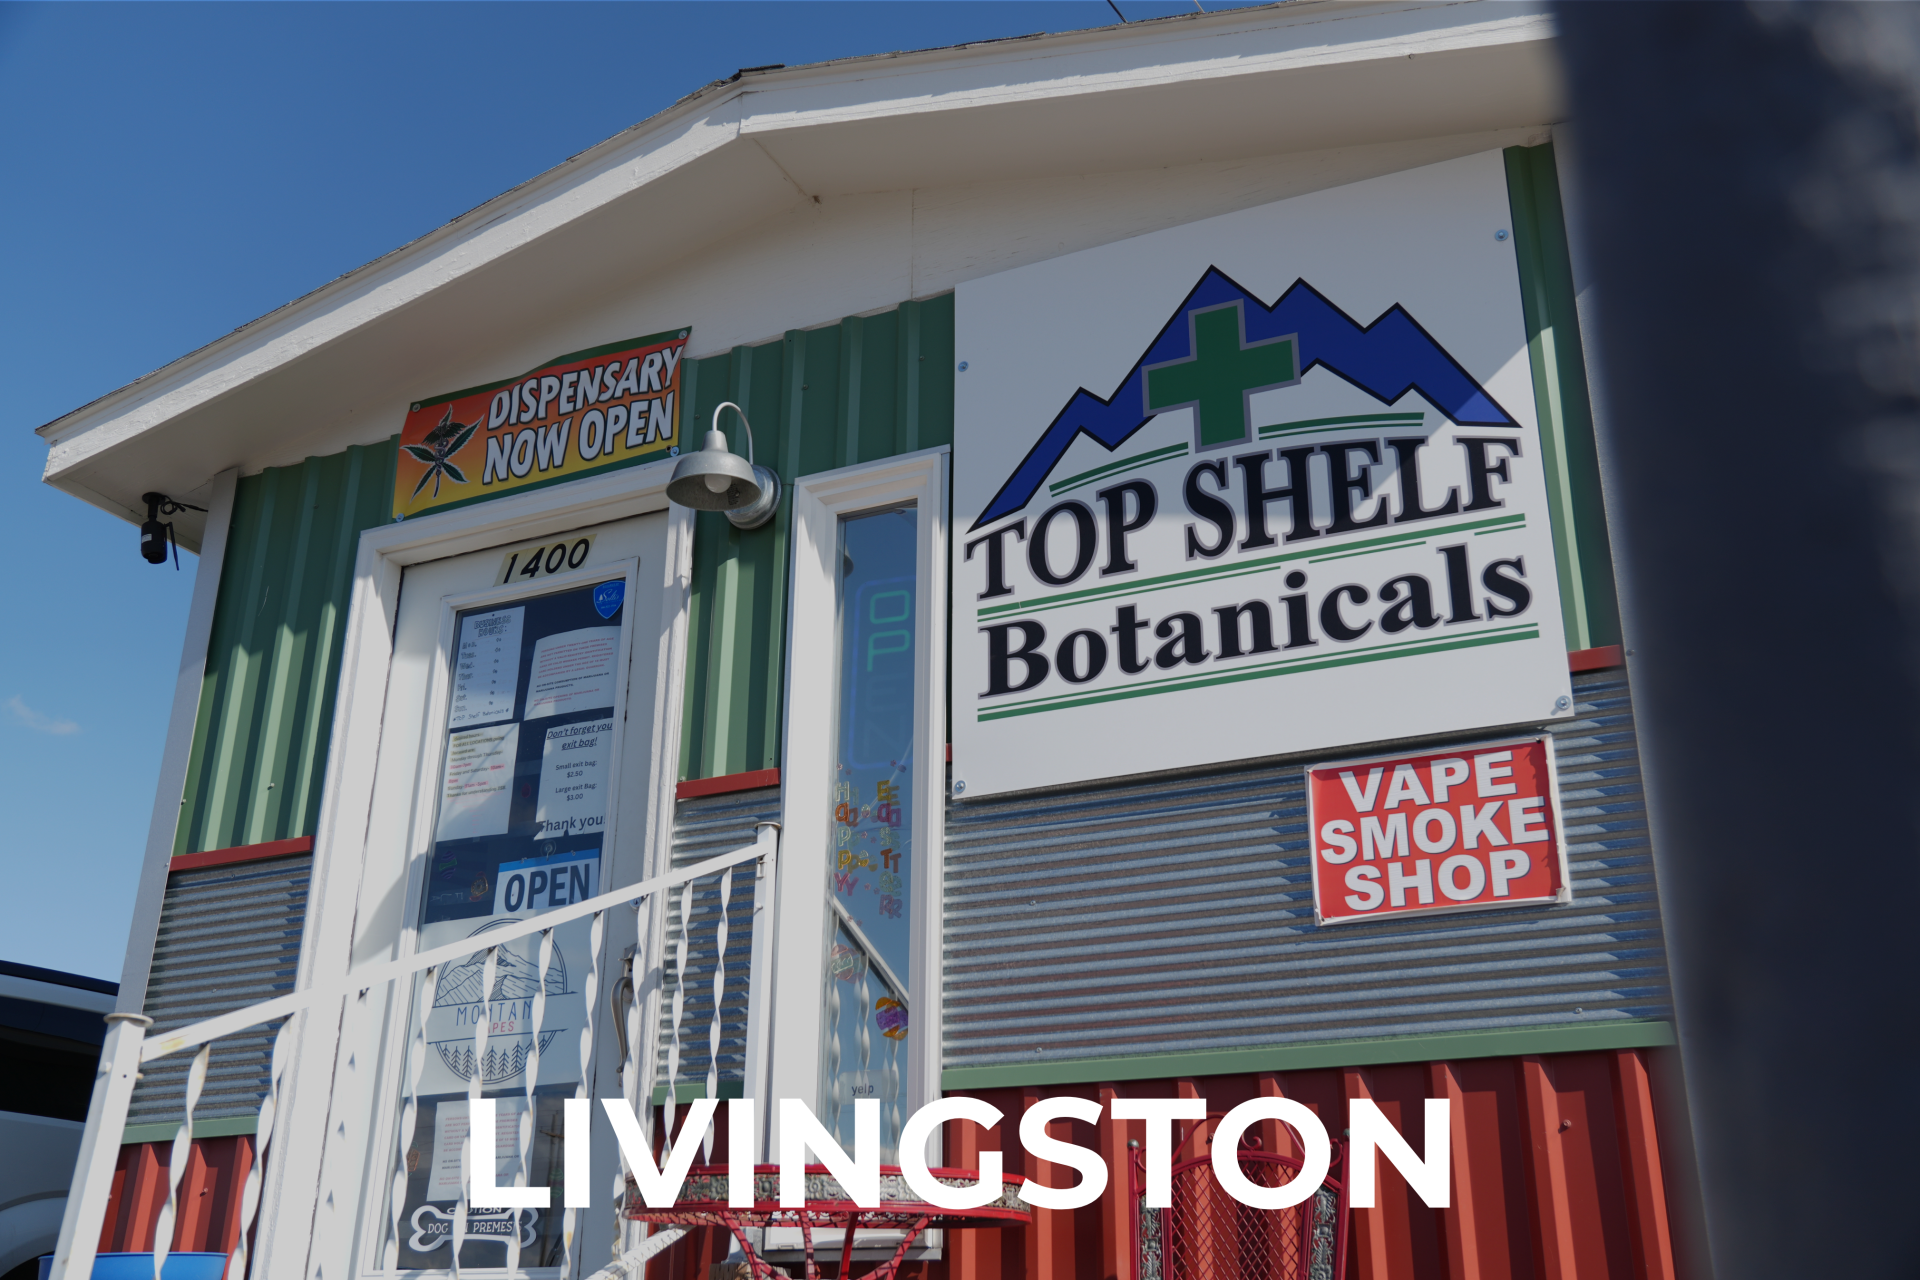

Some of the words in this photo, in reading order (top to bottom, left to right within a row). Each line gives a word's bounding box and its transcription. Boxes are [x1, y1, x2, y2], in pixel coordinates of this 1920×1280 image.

[488, 345, 684, 430] DISPENSARY
[482, 417, 573, 485] NOW
[578, 391, 675, 461] OPEN
[964, 477, 1160, 602] TOP
[1182, 436, 1524, 561] SHELF
[503, 538, 590, 584] 1400
[979, 542, 1533, 699] Botanicals
[547, 728, 569, 740] Don't
[570, 724, 596, 737] forget
[561, 740, 578, 751] exit
[578, 737, 598, 749] bag!
[555, 762, 572, 770] Small
[572, 761, 584, 769] exit
[584, 760, 597, 768] bag:
[566, 770, 583, 778] $2.50
[555, 785, 571, 794] Large
[1340, 751, 1518, 814] VAPE
[566, 793, 583, 801] $3.00
[540, 816, 577, 832] Thank
[1320, 796, 1550, 866] SMOKE
[504, 863, 590, 913] OPEN
[1344, 849, 1532, 912] SHOP
[456, 1000, 532, 1026] MONTAN
[851, 1083, 874, 1097] yelp
[427, 1222, 449, 1234] DOG
[473, 1220, 522, 1233] PREMES
